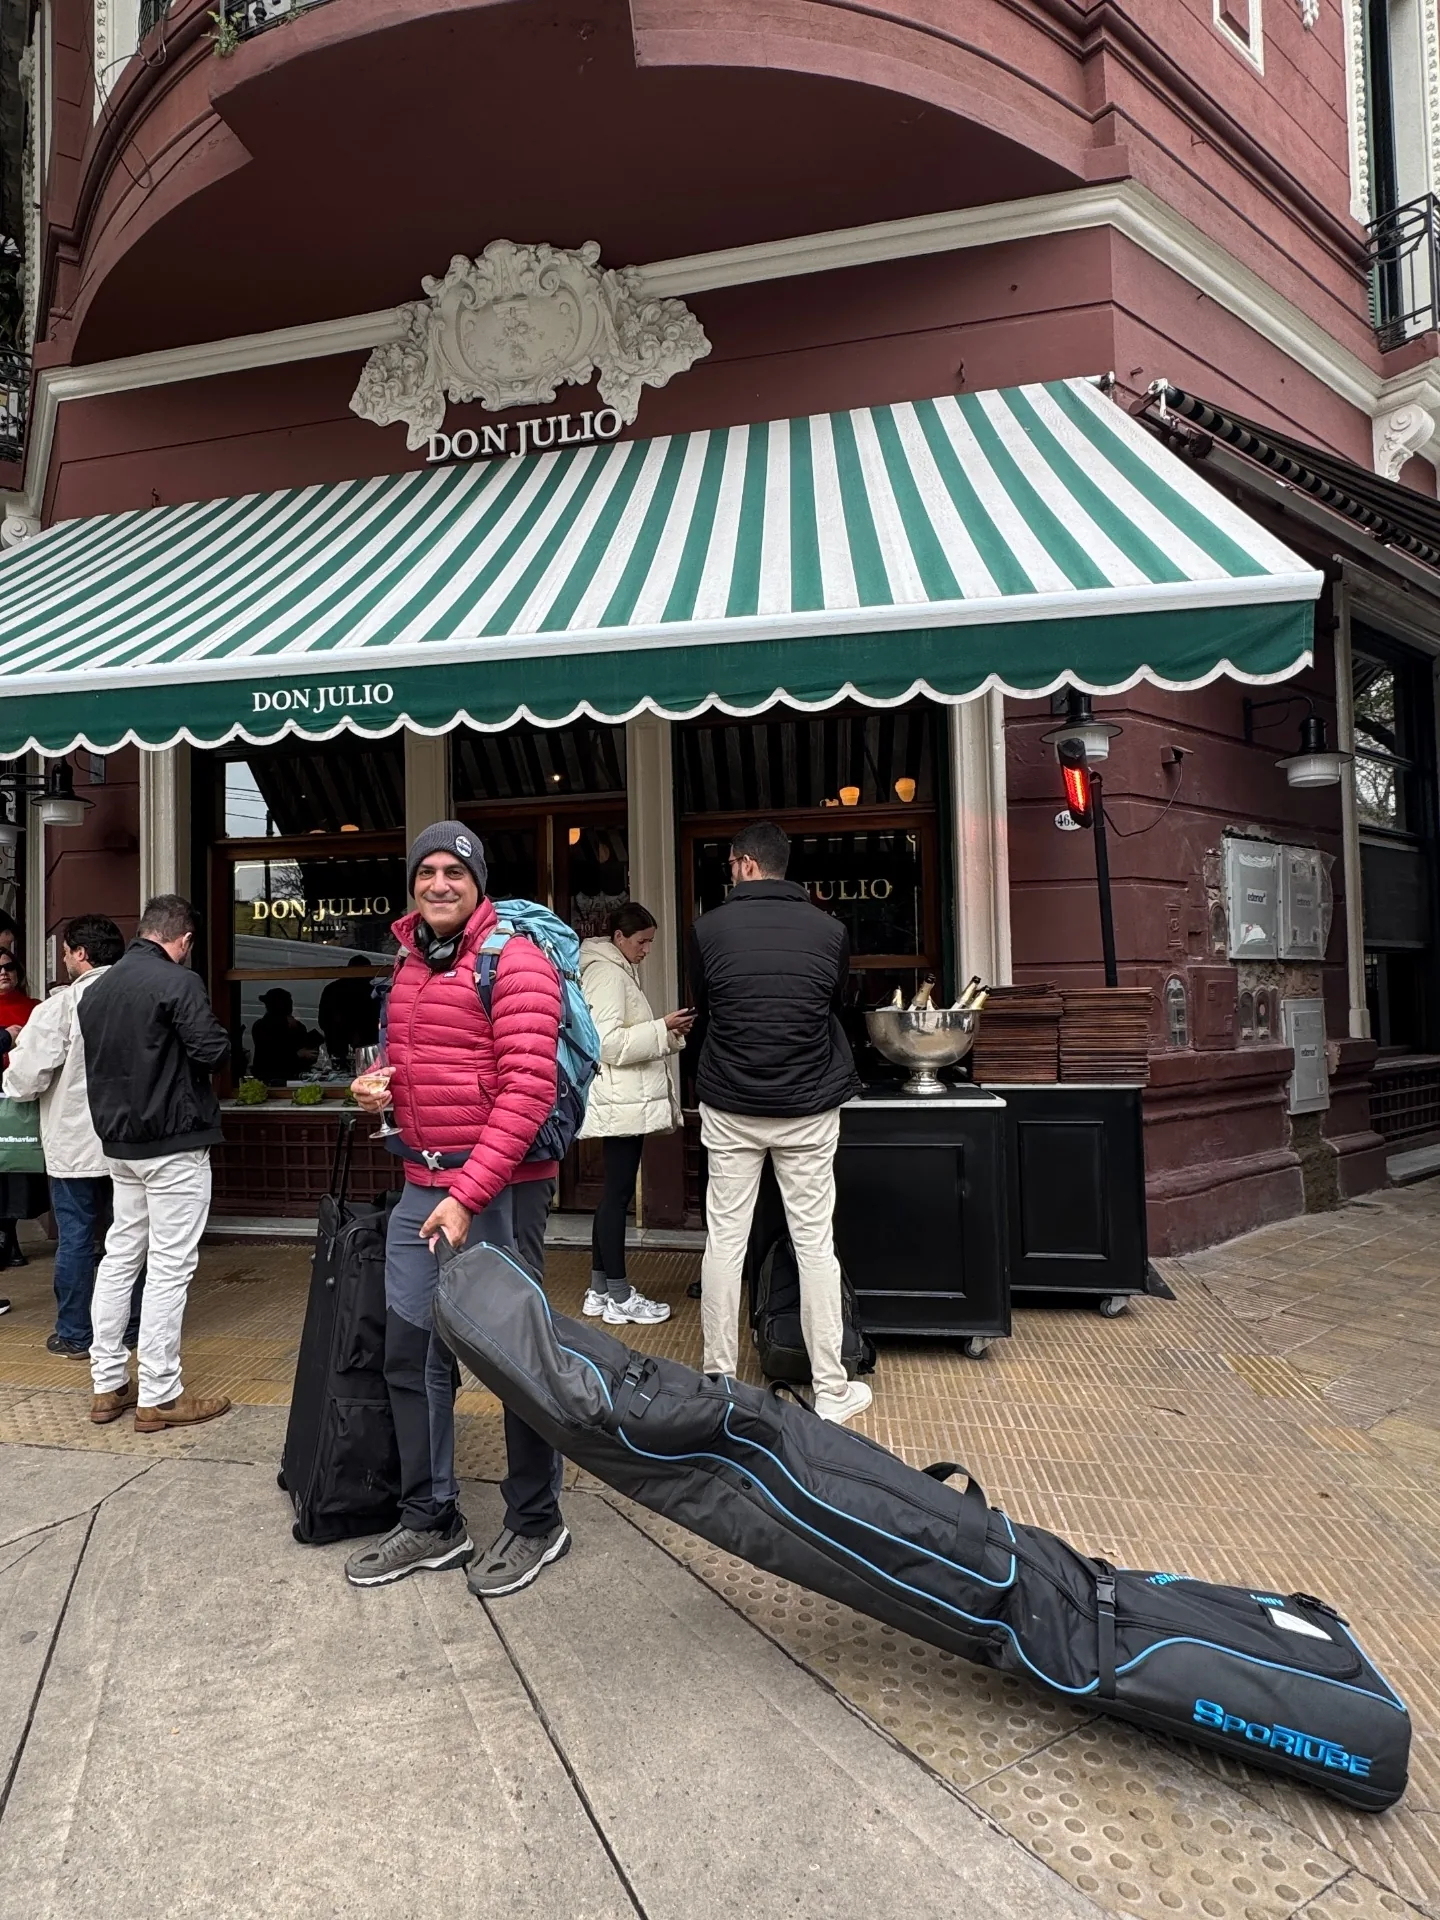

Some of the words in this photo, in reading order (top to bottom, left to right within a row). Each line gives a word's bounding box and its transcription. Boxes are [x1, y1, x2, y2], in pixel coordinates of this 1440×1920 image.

[426, 423, 508, 463] DON
[510, 408, 624, 459] JULIO
[252, 688, 311, 712] DON
[313, 683, 394, 714] JULIO
[253, 898, 308, 921] DON
[313, 896, 391, 922] JULIO
[302, 925, 347, 933] PARRILLA
